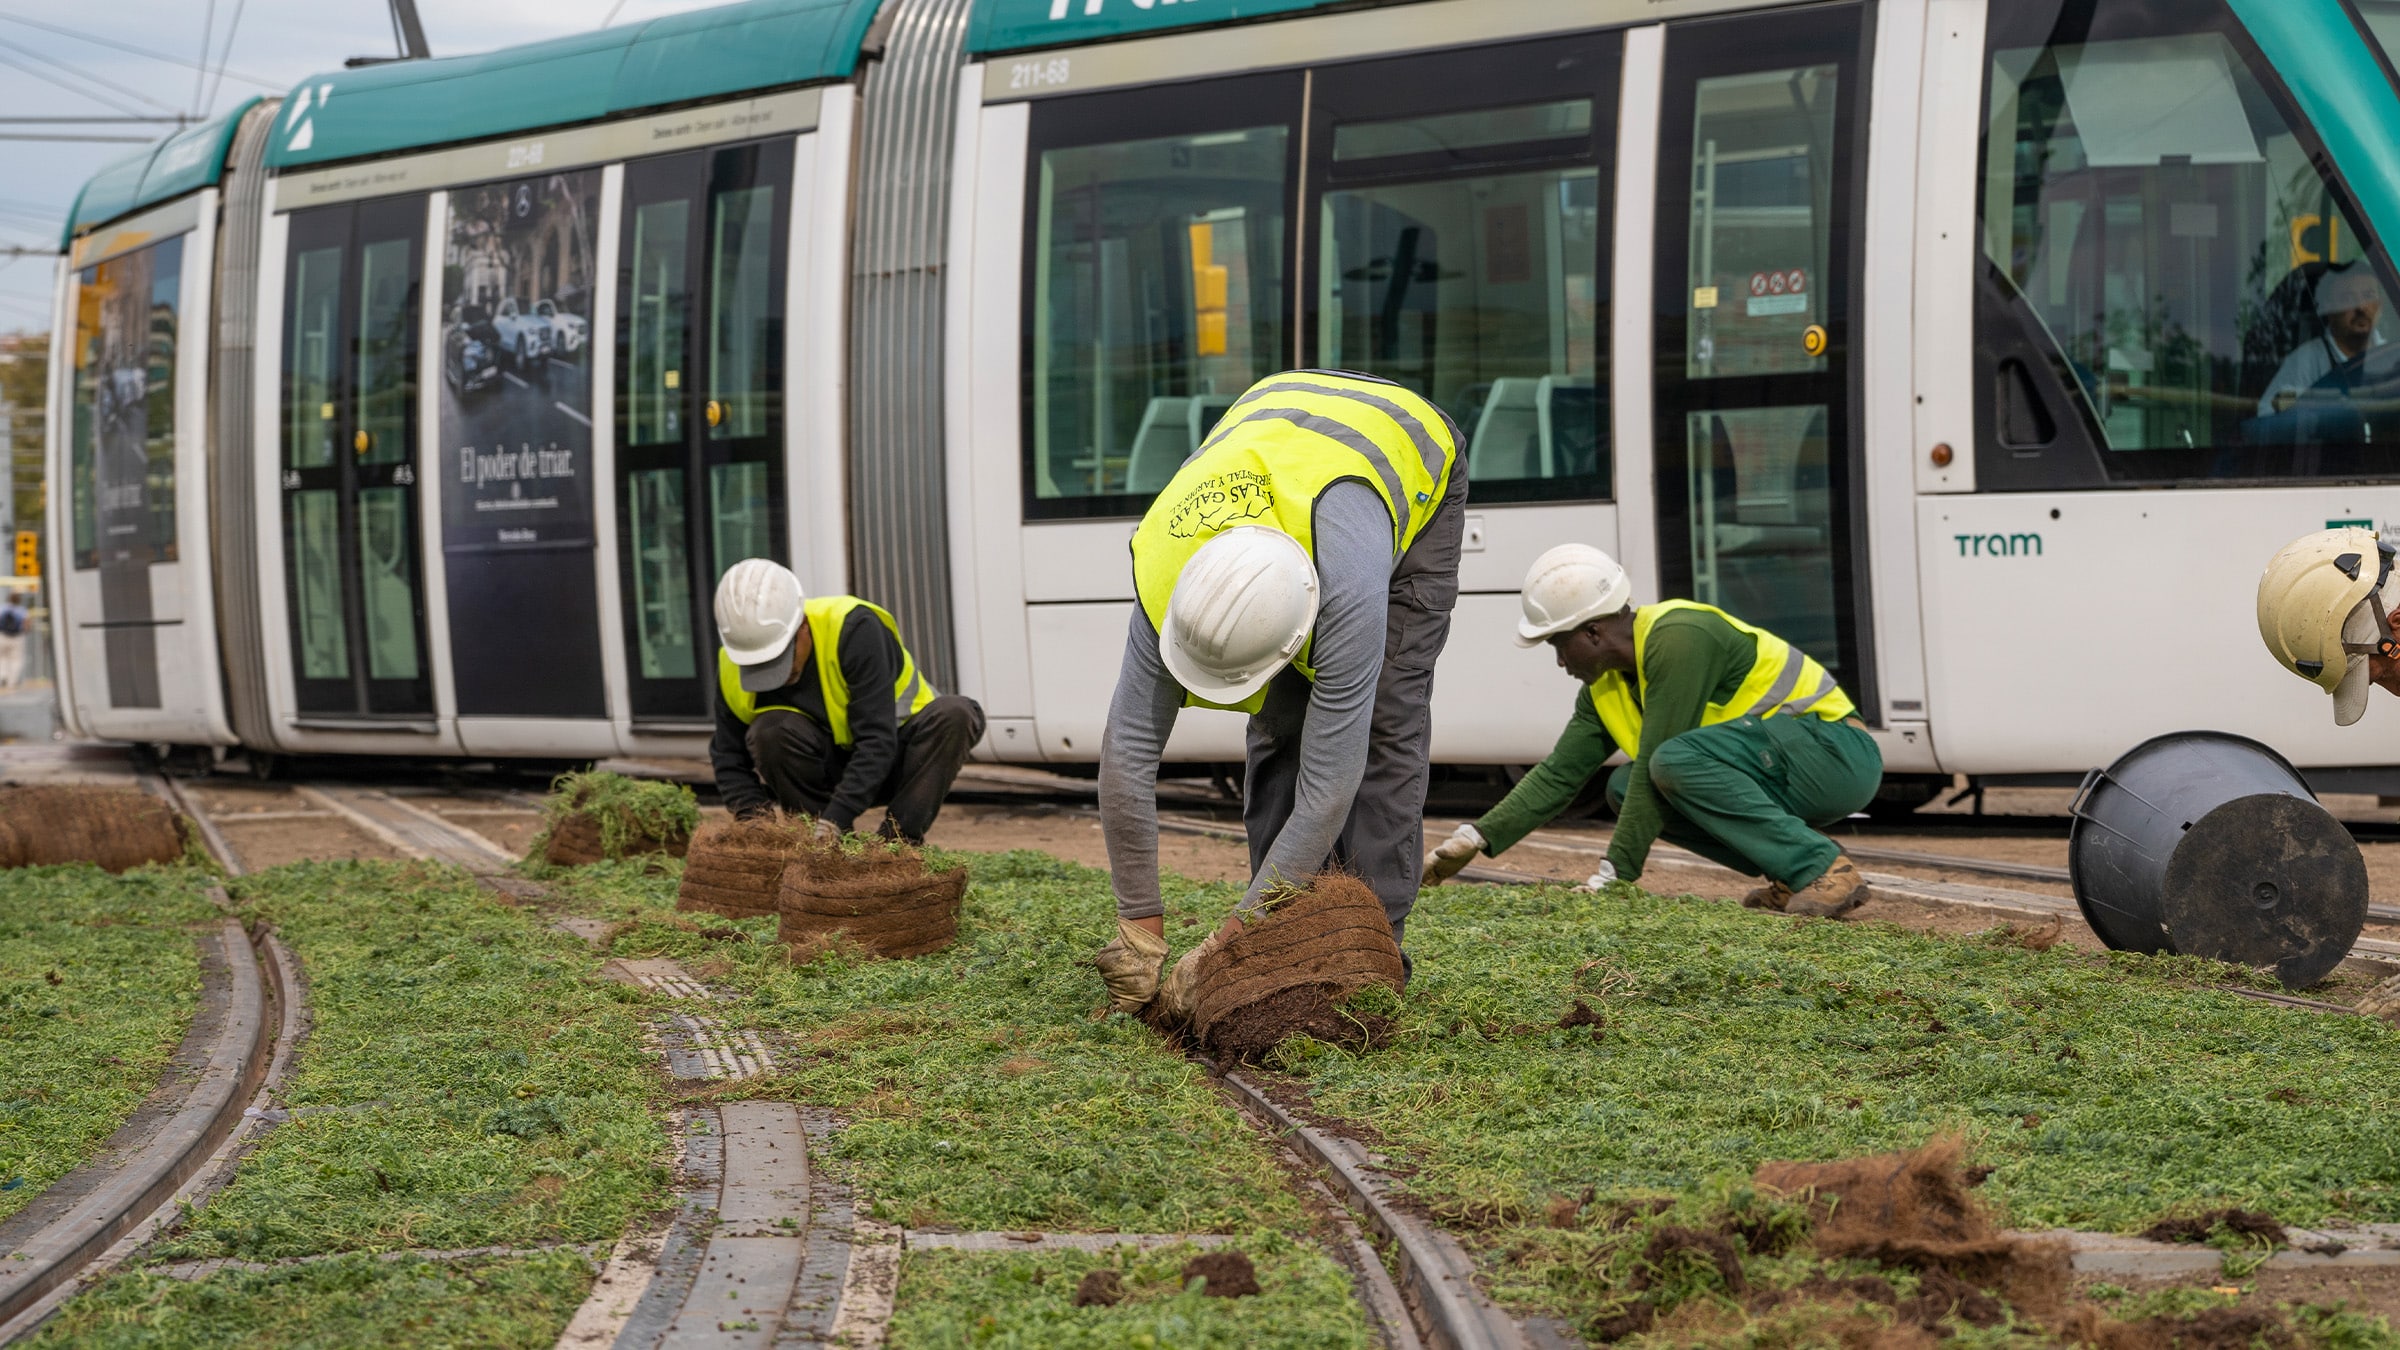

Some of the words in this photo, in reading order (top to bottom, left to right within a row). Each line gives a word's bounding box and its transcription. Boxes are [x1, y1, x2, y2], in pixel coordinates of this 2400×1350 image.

[1010, 58, 1070, 88] 211-68
[460, 446, 476, 482] El
[477, 444, 518, 489] poder
[519, 442, 538, 479] de
[1168, 491, 1226, 533] GALAXY
